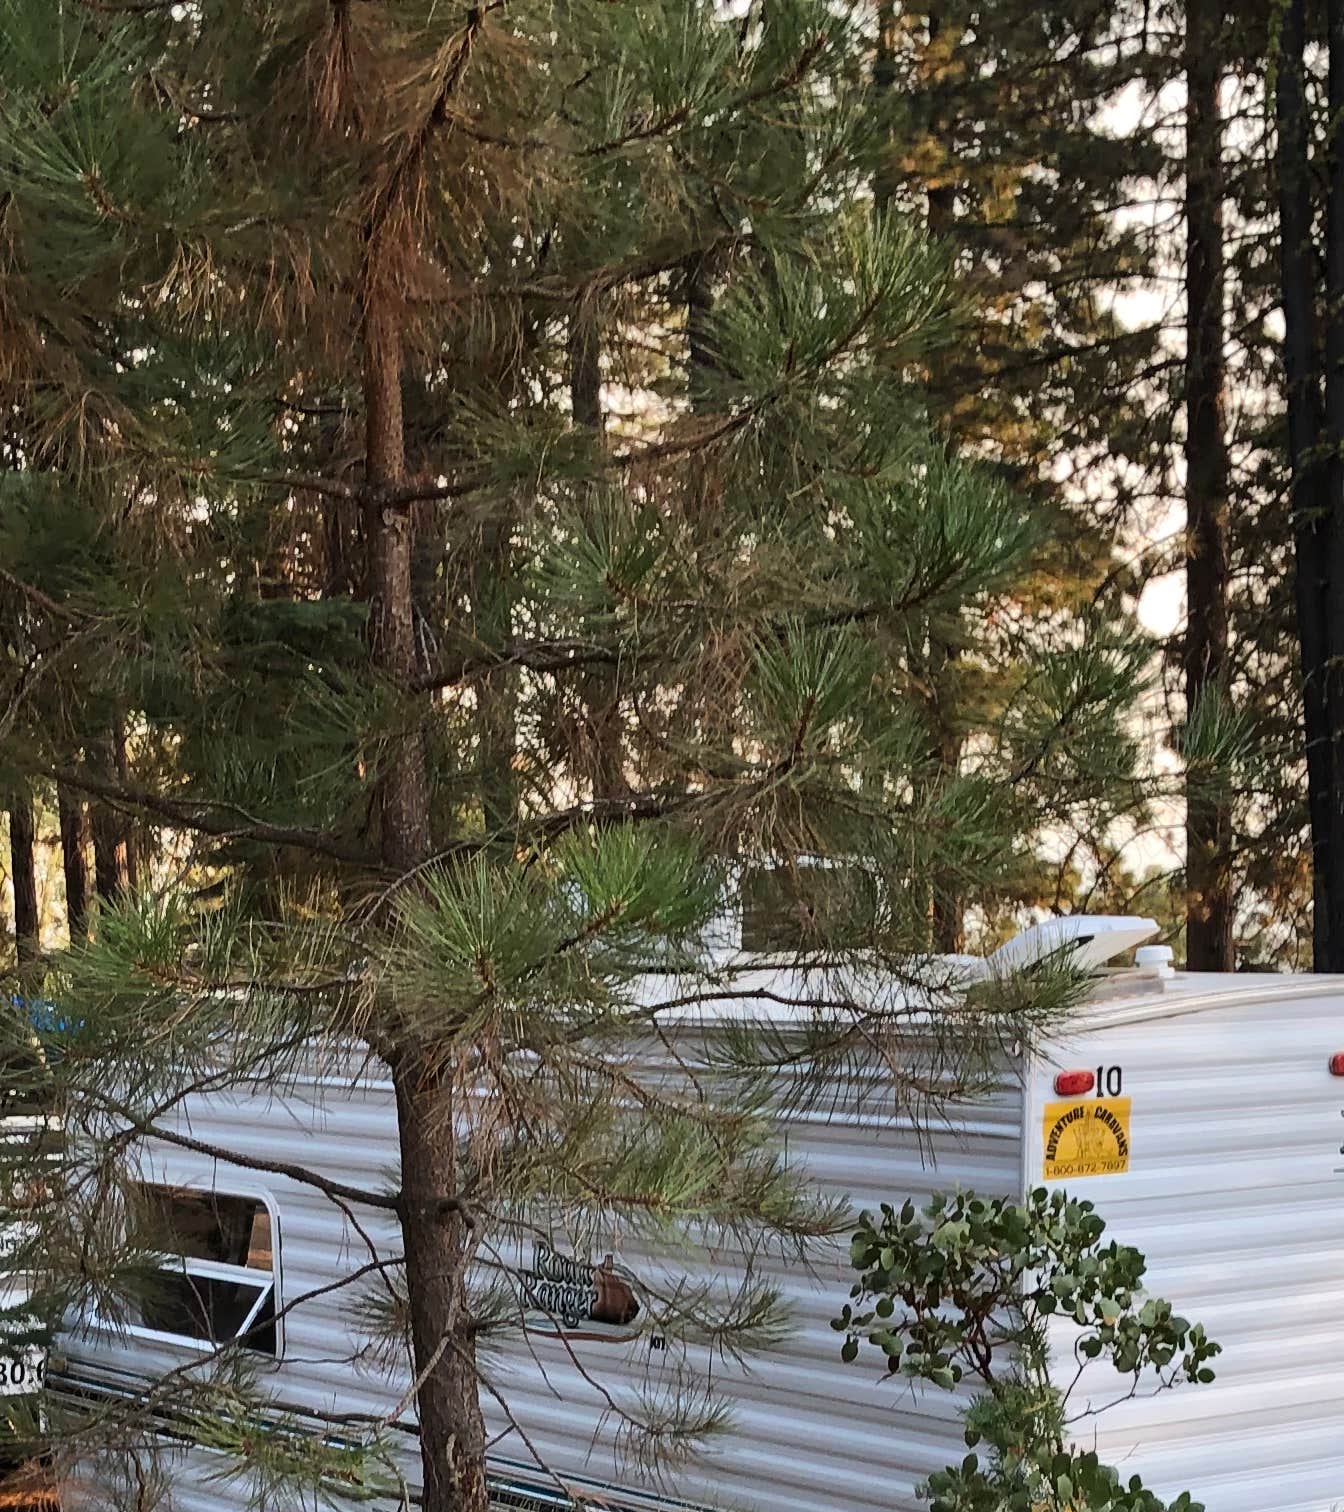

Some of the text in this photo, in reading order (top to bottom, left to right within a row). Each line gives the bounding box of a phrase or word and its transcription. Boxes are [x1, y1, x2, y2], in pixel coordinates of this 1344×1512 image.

[1096, 1066, 1122, 1097] 10
[1045, 1106, 1128, 1161] ADVENTURE CARAVANS
